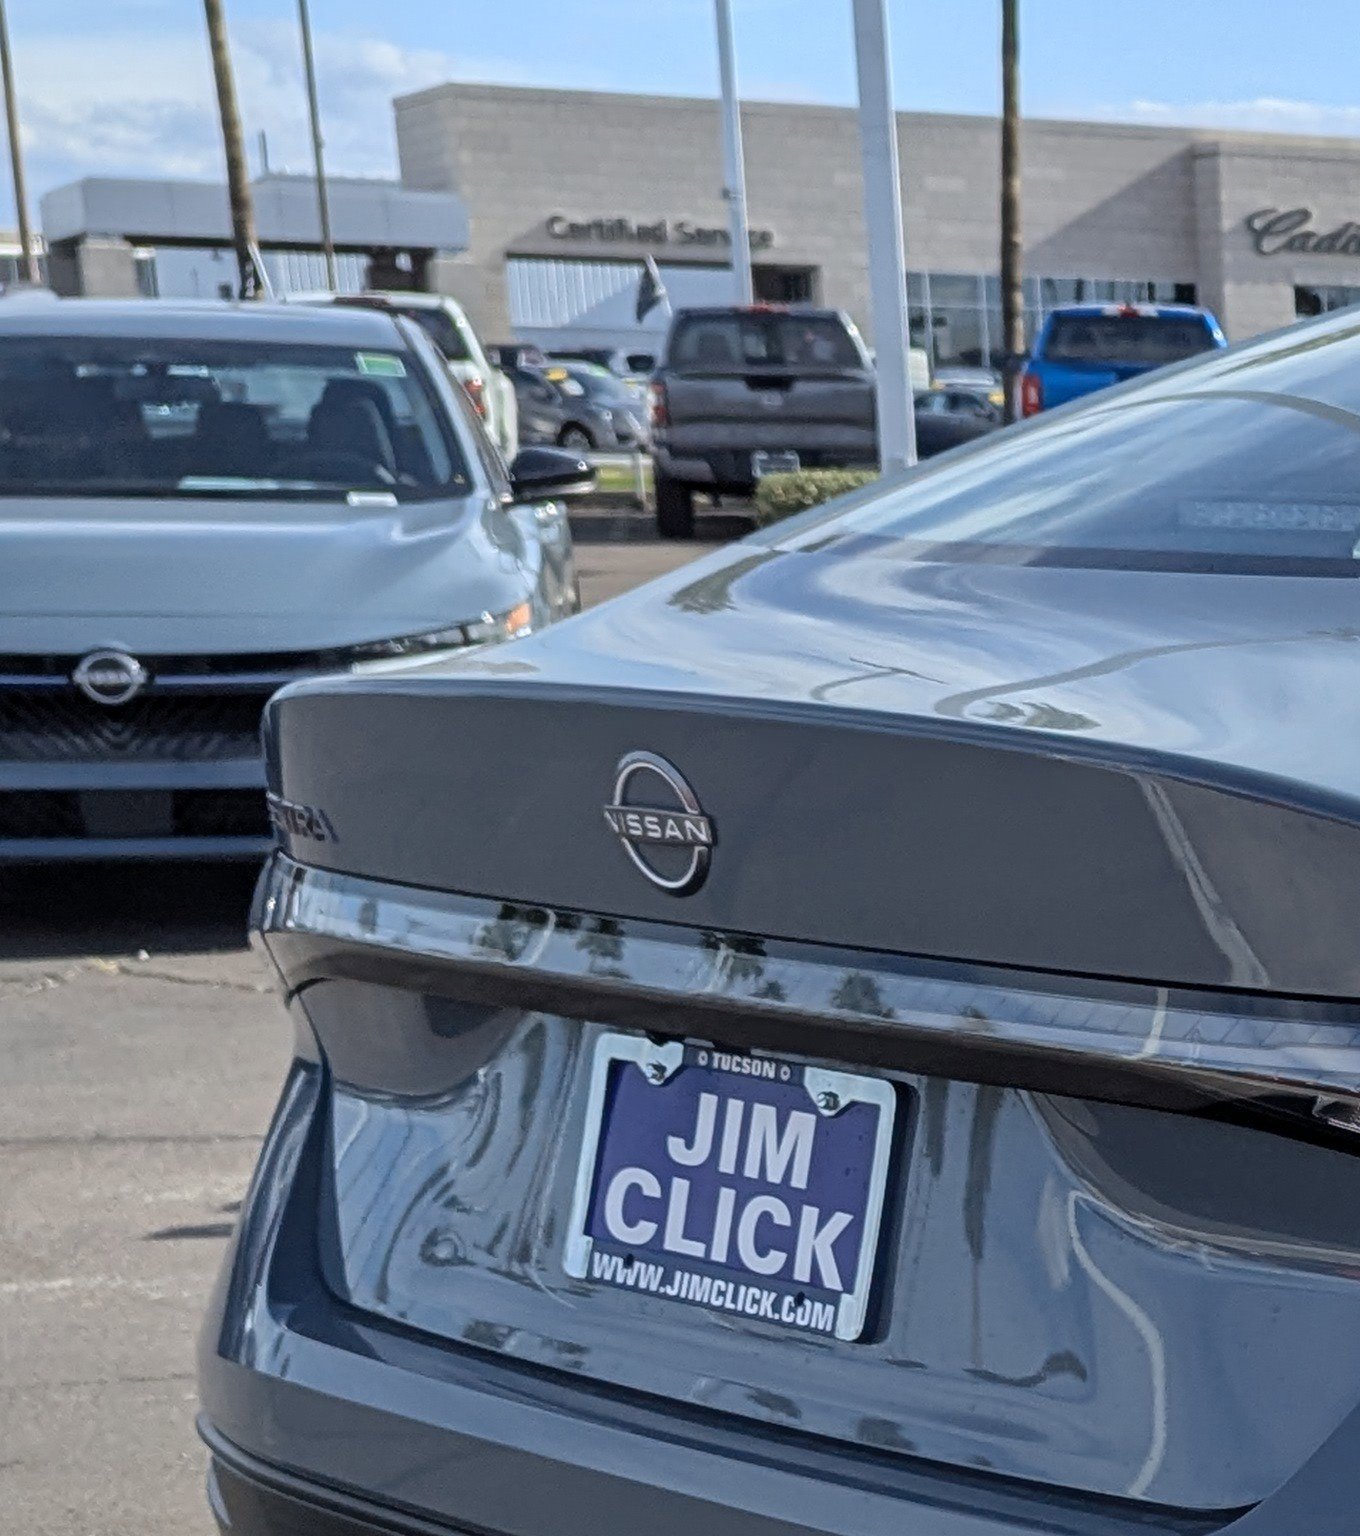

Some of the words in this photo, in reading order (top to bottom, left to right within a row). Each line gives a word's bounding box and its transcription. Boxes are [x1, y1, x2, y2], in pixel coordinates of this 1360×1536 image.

[673, 219, 775, 250] Servce
[604, 810, 709, 843] NISSAN
[712, 1051, 777, 1079] TUCSON
[667, 1092, 817, 1190] JIM
[604, 1167, 854, 1292] CLICK
[591, 1251, 836, 1332] WWW.JIMCLICK.COM
